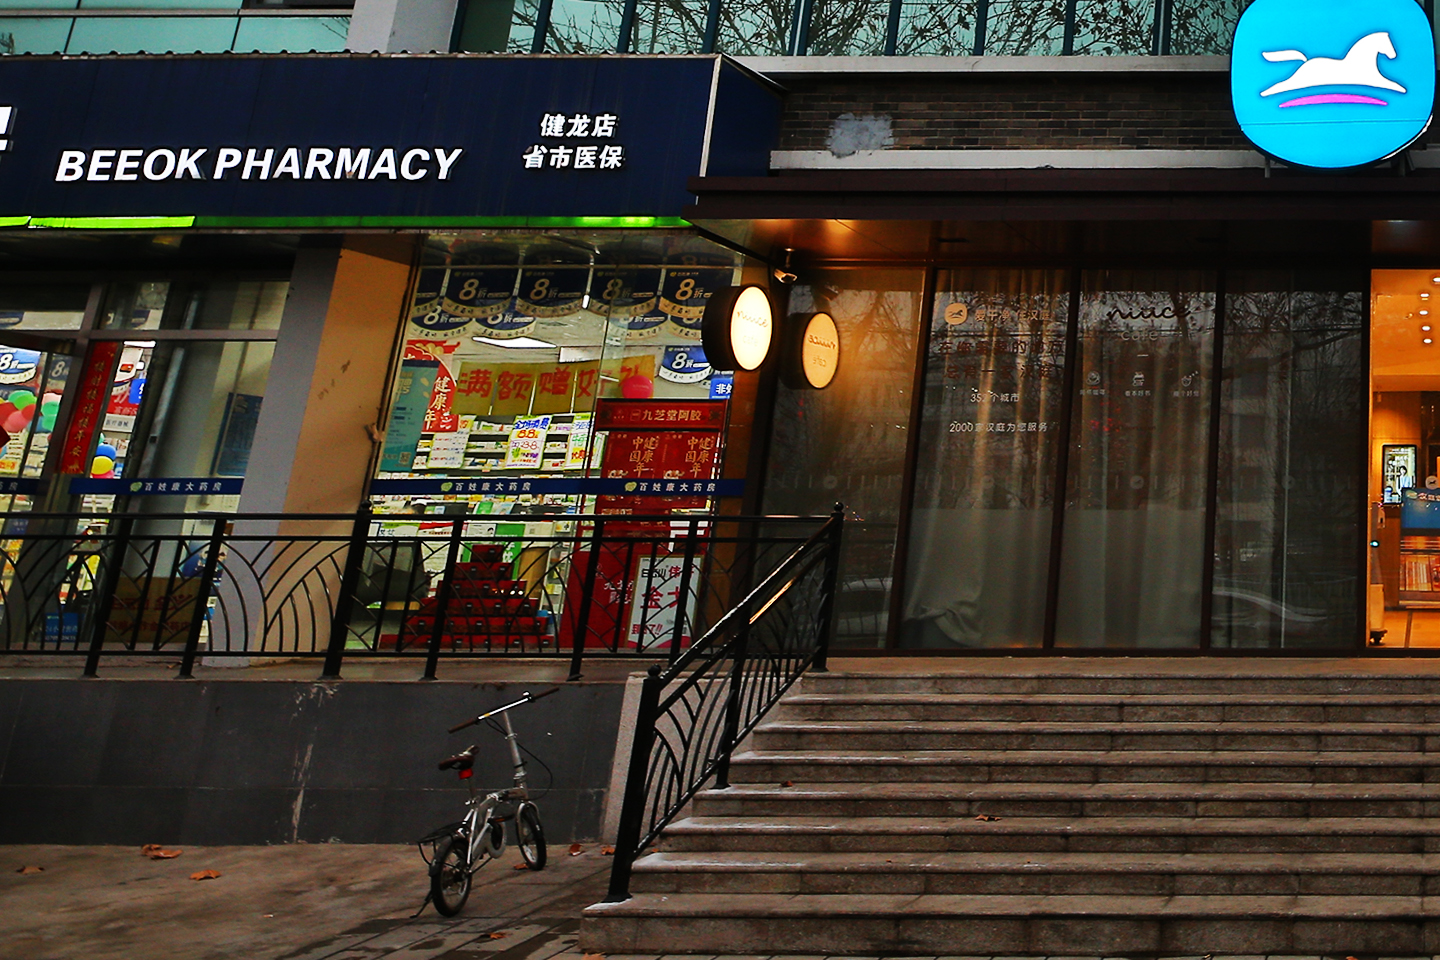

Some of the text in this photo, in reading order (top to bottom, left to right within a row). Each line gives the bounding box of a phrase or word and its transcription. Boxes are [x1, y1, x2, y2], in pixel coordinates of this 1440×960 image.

[540, 113, 617, 138] 健龙店
[522, 145, 624, 169] 省市医保
[55, 149, 463, 182] BEEOK PHARMACY
[642, 409, 702, 421] 九芝堂阿胶
[145, 482, 222, 492] 百姓康大药房
[455, 482, 532, 492] 百姓康大药房
[640, 482, 716, 492] 百姓康大药房
